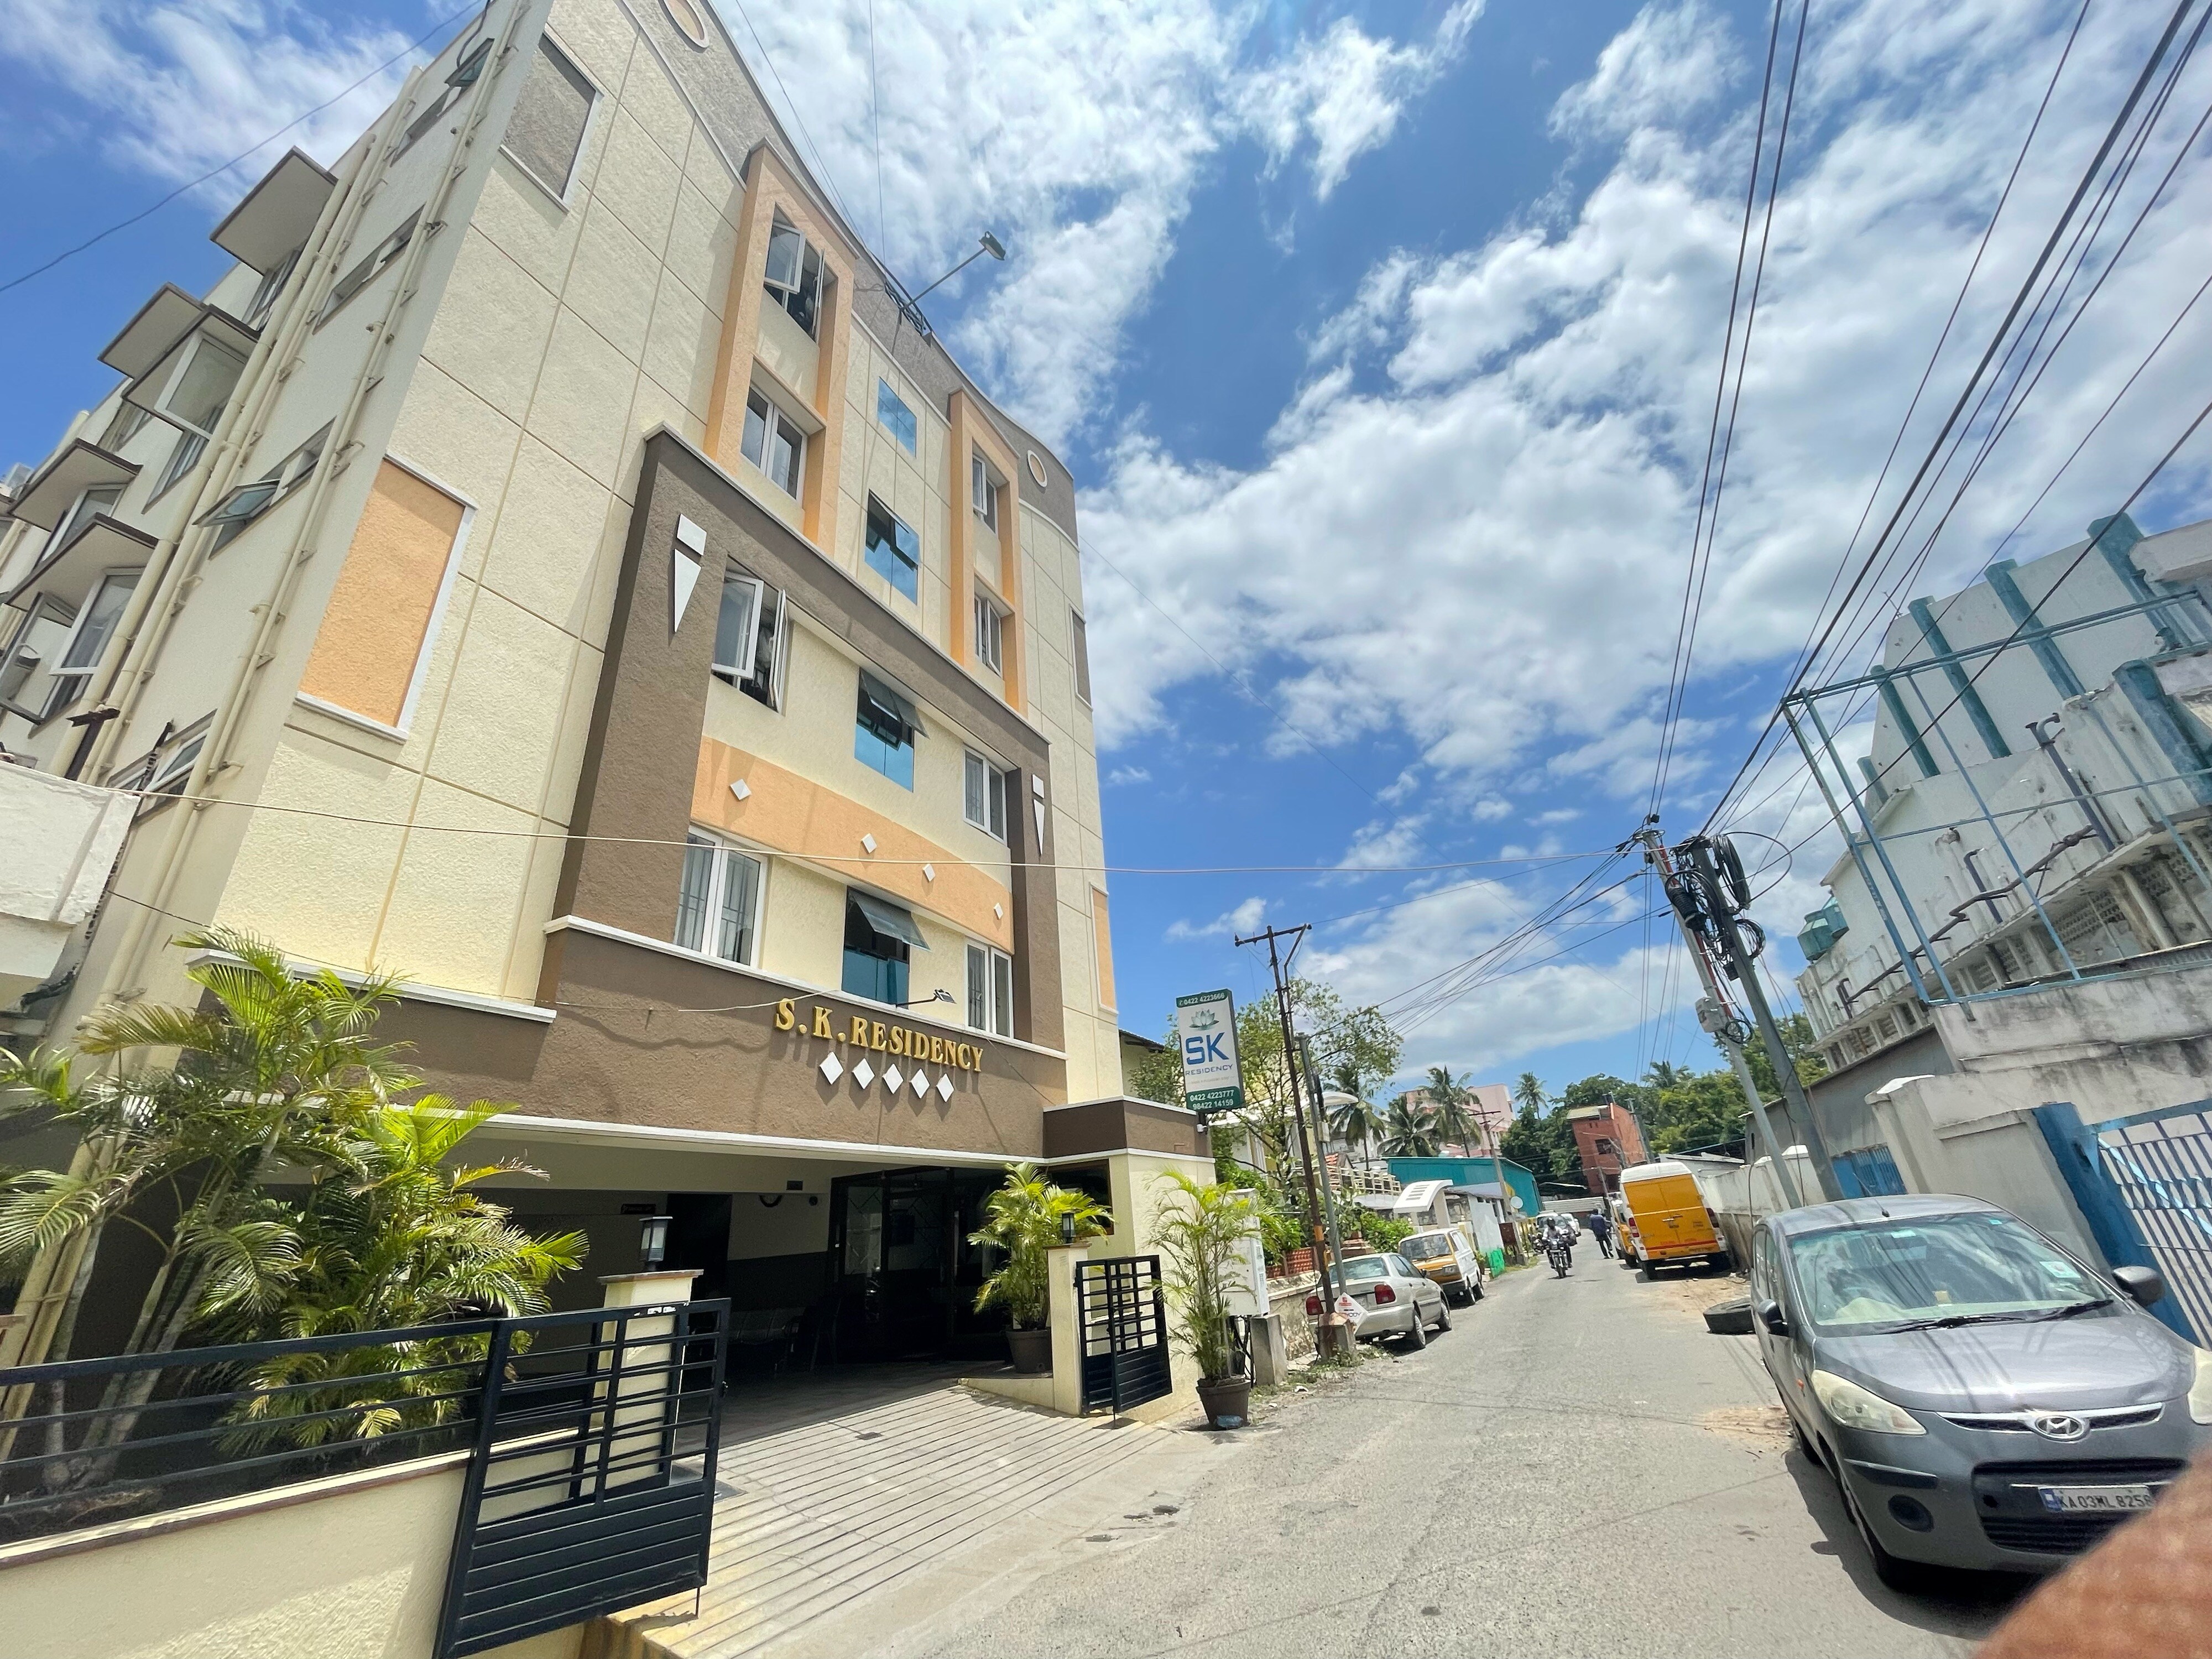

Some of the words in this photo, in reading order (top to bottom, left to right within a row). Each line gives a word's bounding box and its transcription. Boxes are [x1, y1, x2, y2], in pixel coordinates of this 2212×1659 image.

[1186, 1032, 1229, 1065] SK
[1185, 1064, 1233, 1076] RESIDENCY
[1190, 1093, 1206, 1102] 0422
[1207, 1089, 1234, 1099] 4223777
[1192, 1102, 1212, 1110] 98422
